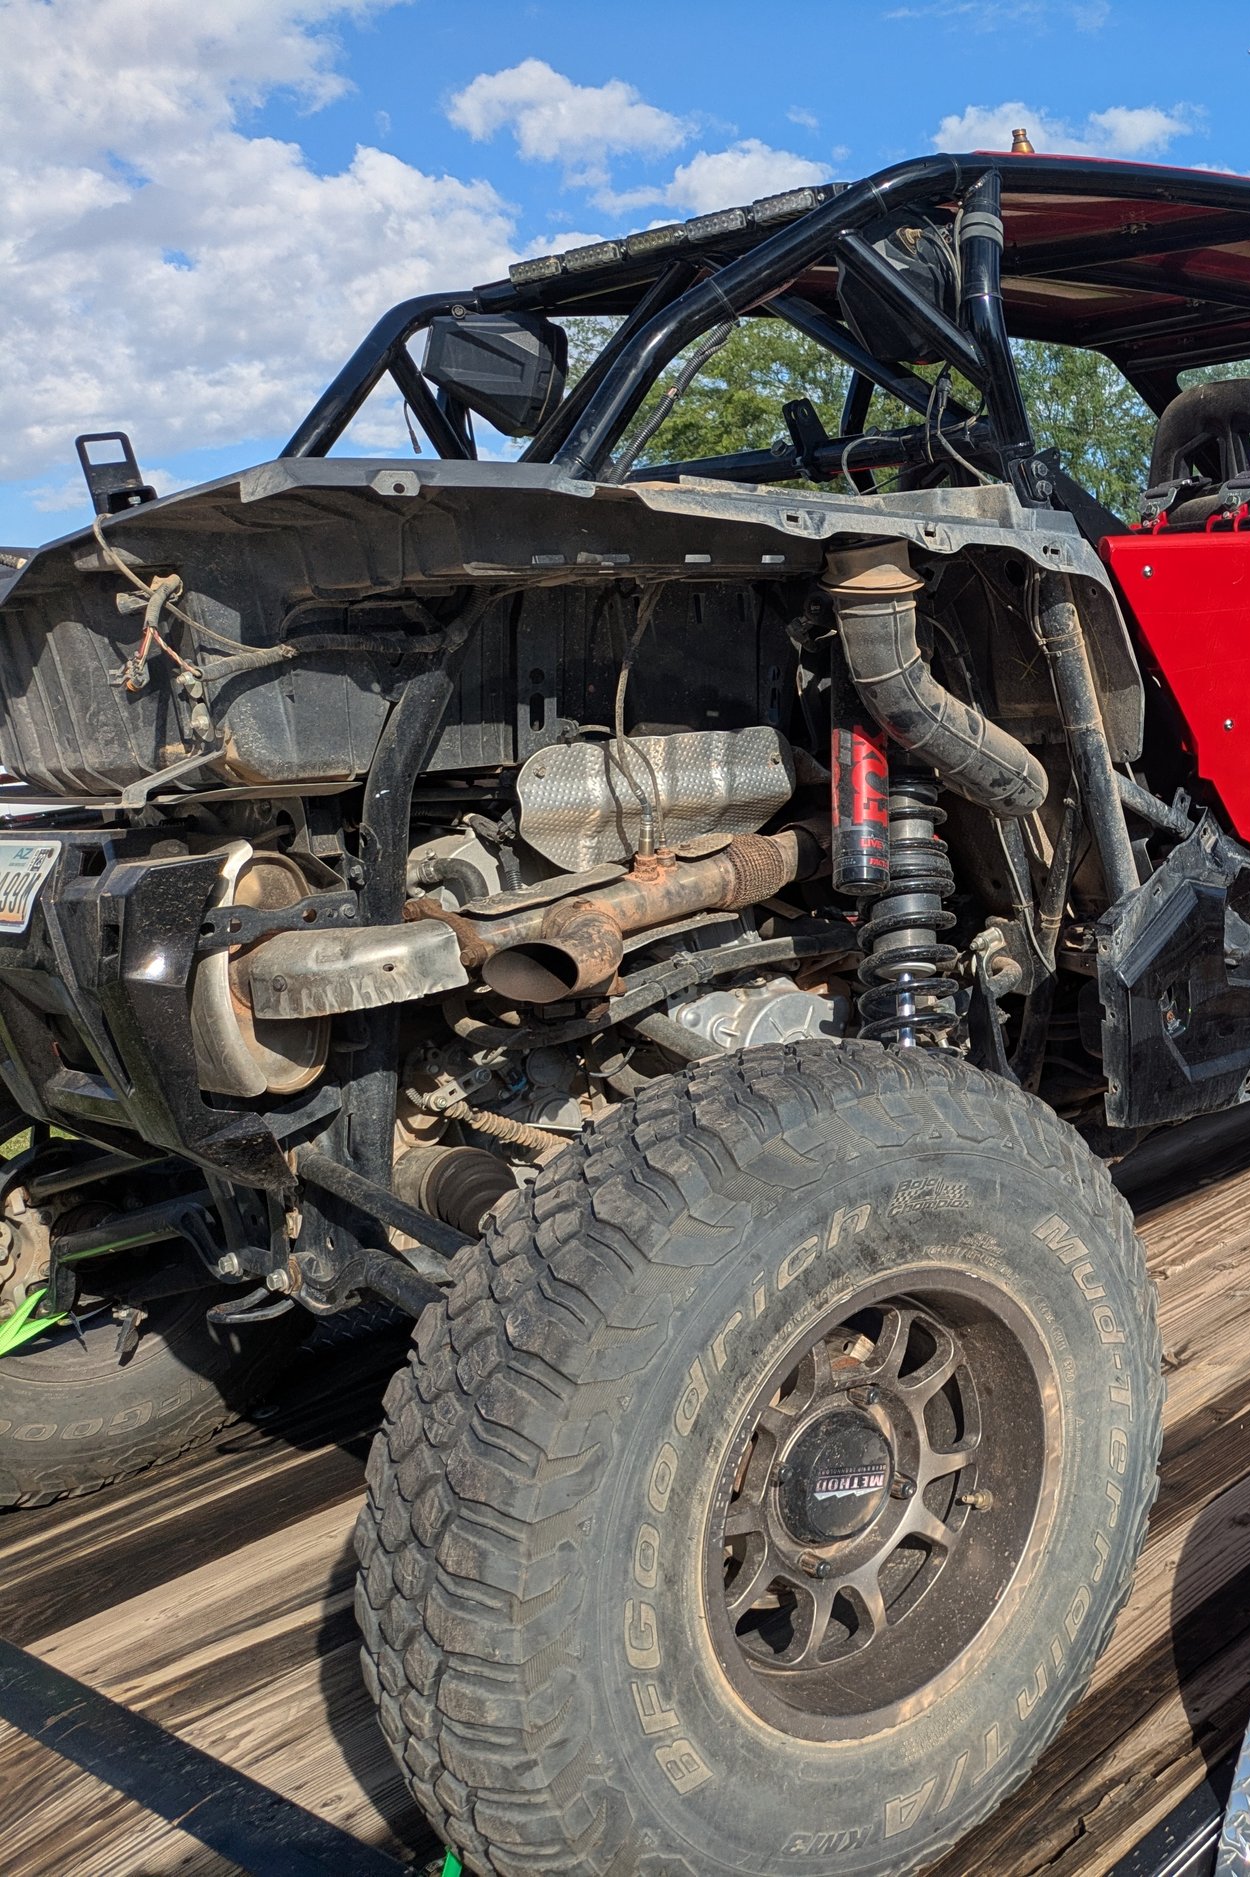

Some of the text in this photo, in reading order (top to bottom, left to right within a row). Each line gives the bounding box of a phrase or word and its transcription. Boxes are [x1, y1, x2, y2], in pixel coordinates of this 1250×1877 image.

[852, 725, 888, 828] FOX
[13, 848, 33, 859] AZ
[887, 1200, 971, 1218] Champion
[624, 1202, 871, 1796] BFGoodrich
[815, 1474, 885, 1492] METHOD
[883, 1723, 1010, 1840] T/A
[780, 1824, 873, 1856] KM3
